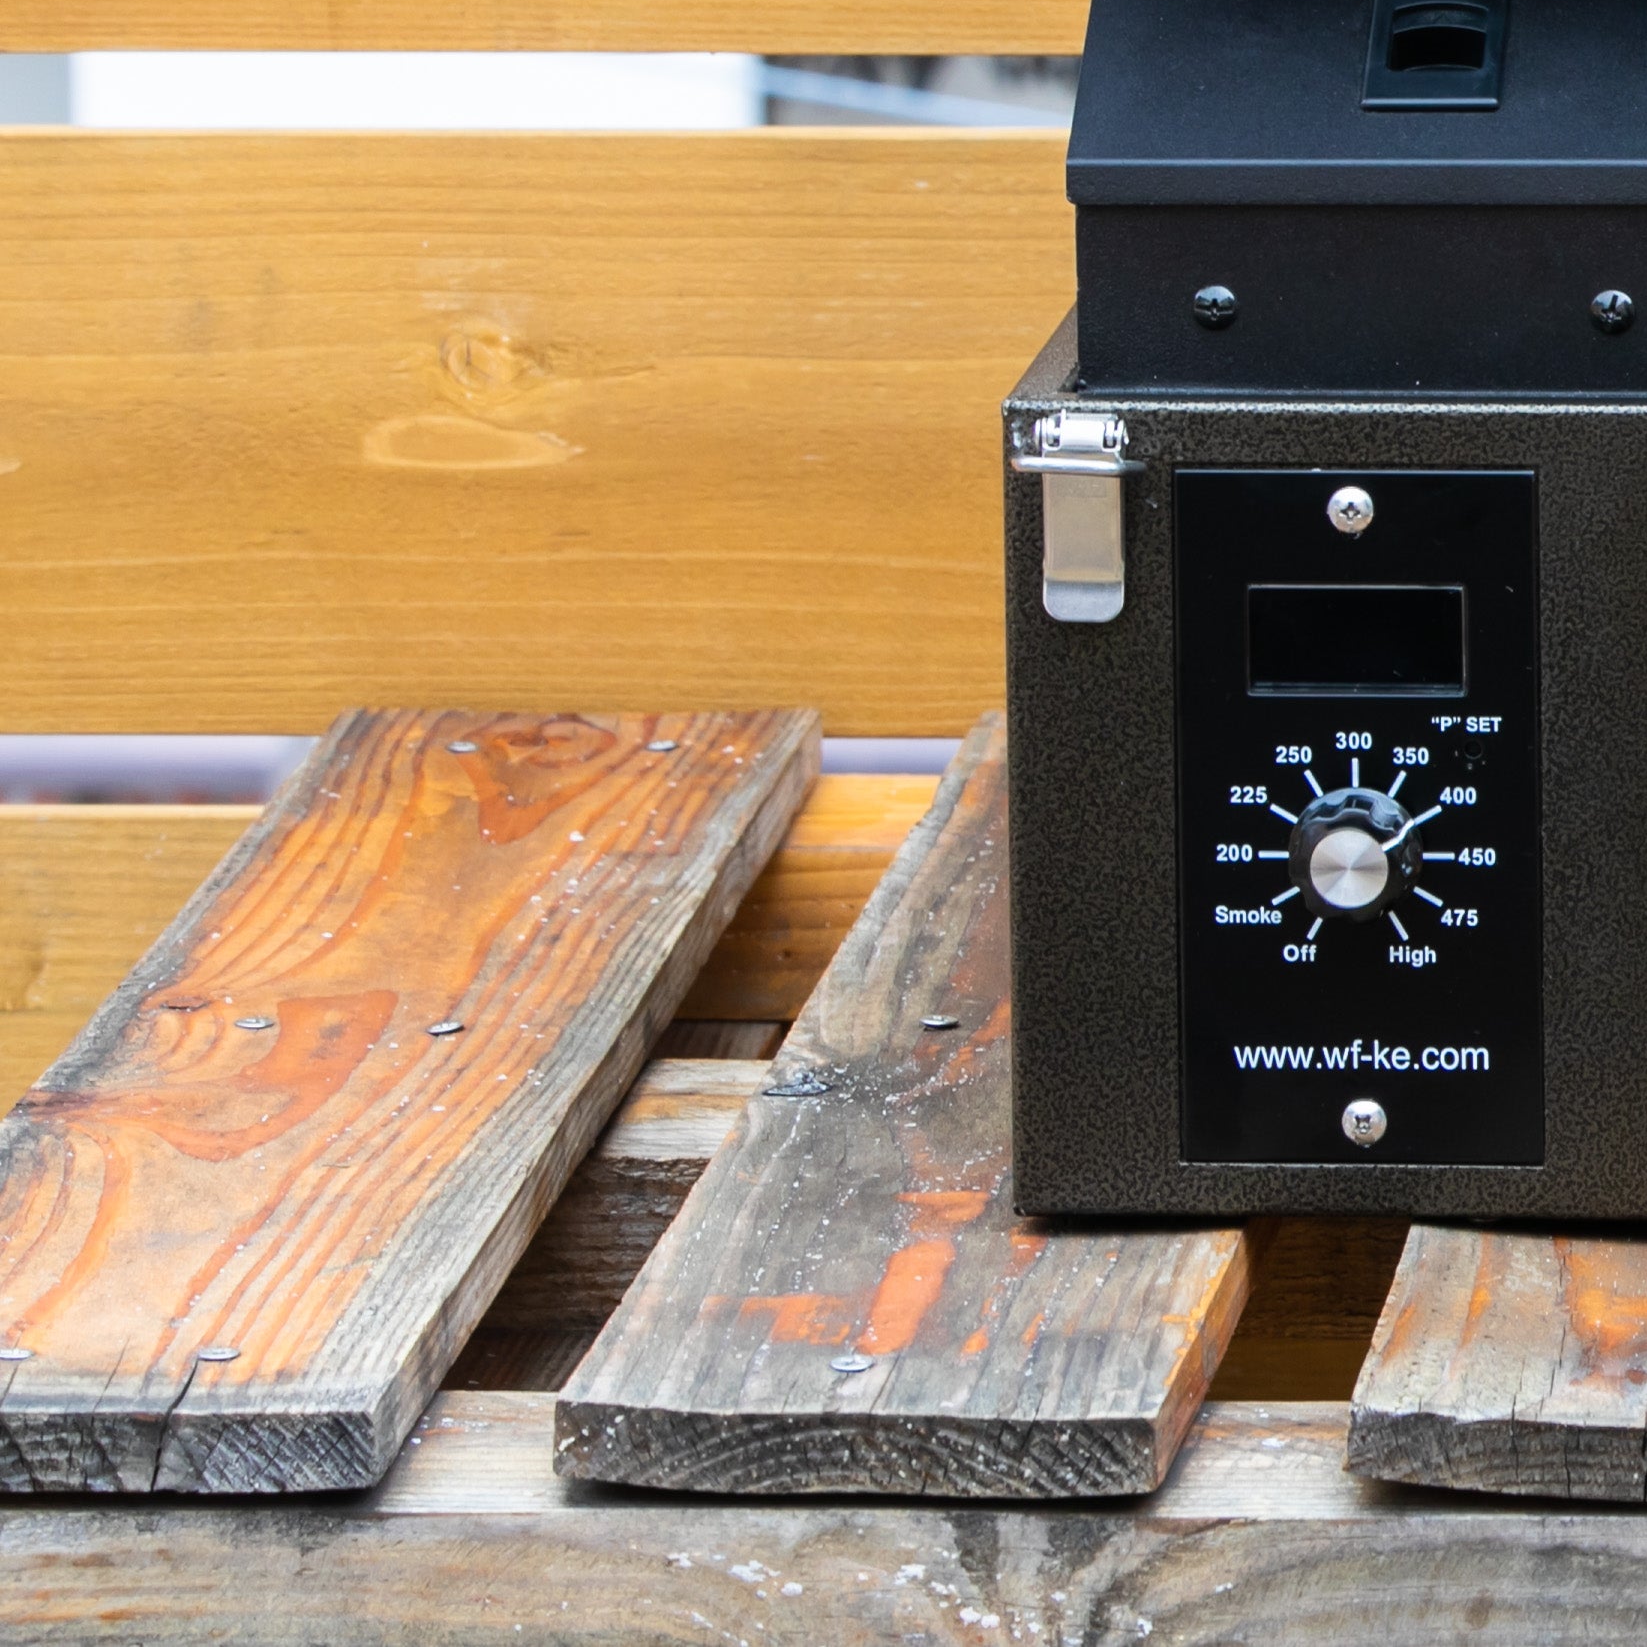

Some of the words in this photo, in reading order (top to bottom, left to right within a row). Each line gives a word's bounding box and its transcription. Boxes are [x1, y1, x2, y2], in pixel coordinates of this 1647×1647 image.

[1465, 715, 1503, 733] SET
[1335, 731, 1373, 750] 300
[1275, 745, 1313, 764] 250
[1392, 746, 1430, 766] 350
[1229, 785, 1268, 804] 225
[1439, 786, 1478, 805] 400
[1216, 843, 1253, 863] 200
[1457, 847, 1497, 866] 450
[1215, 905, 1283, 925] Smoke
[1440, 908, 1479, 927] 475
[1282, 943, 1317, 963] Off
[1389, 944, 1437, 968] High
[1233, 1038, 1490, 1071] www.wf-ke.com
